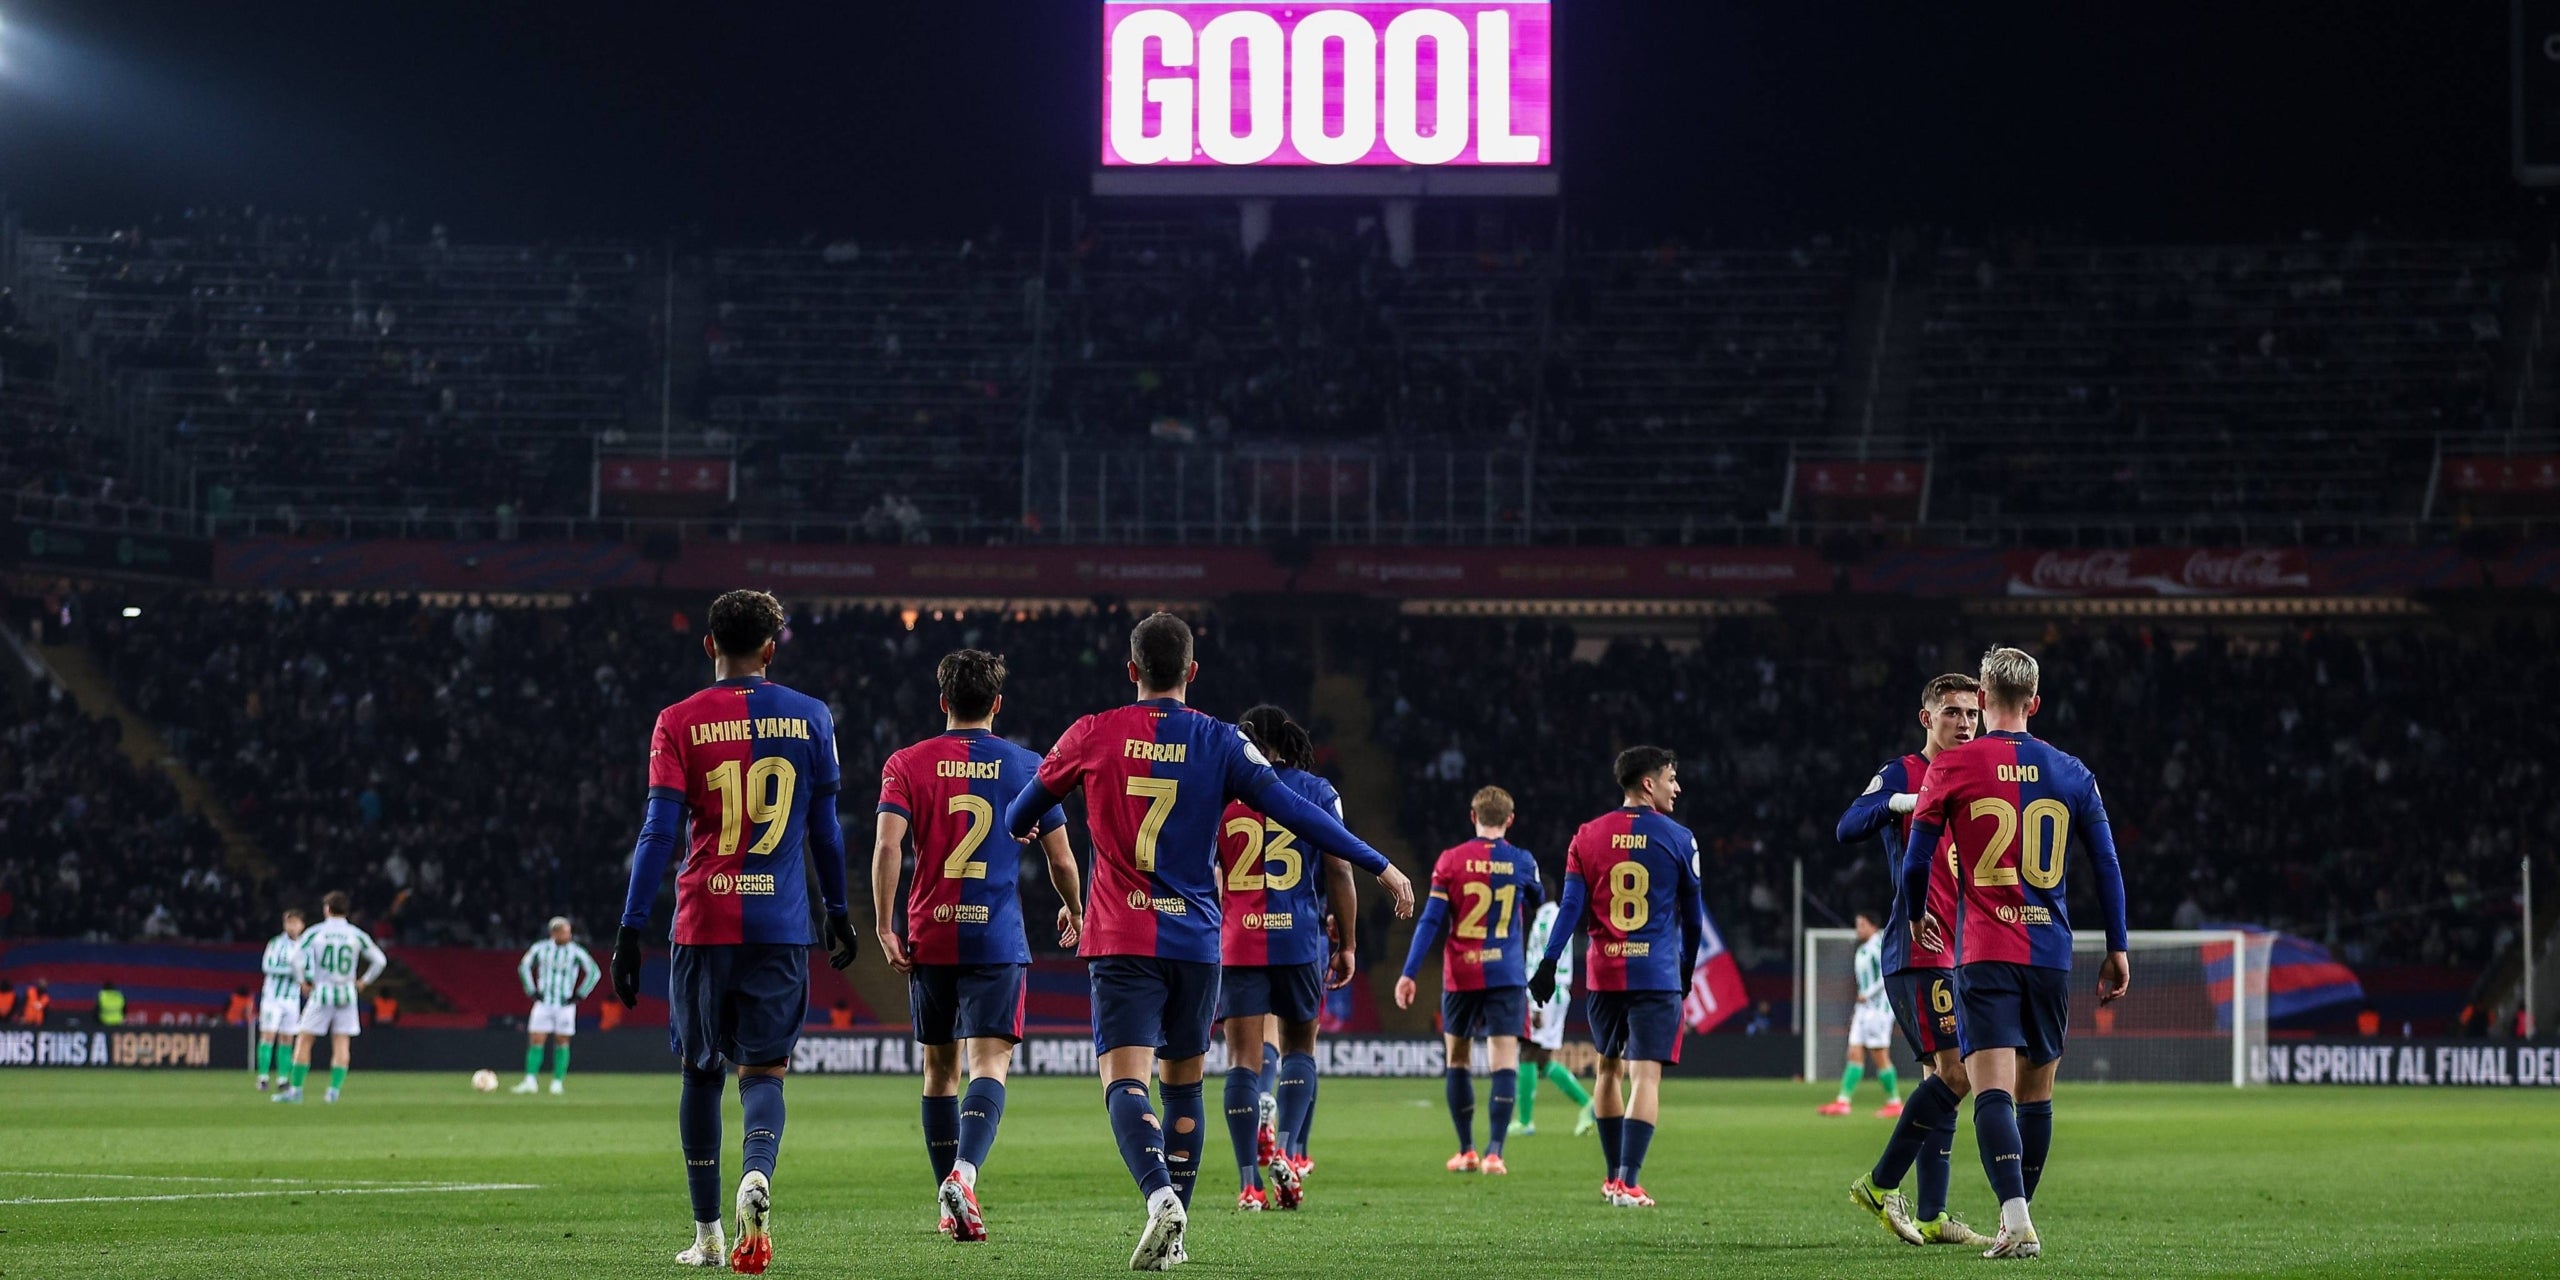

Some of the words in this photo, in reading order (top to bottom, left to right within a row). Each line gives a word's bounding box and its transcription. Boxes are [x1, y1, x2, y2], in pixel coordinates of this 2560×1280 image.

[1110, 8, 1540, 165] GOOOL
[690, 719, 752, 746] LAMINE
[754, 717, 810, 740] YAMAL
[1123, 738, 1187, 763] FERRAN
[936, 759, 1002, 780] CUBARSÍ
[1996, 764, 2039, 783] OLMO
[706, 756, 797, 856] 19
[943, 794, 993, 879] 2
[1126, 775, 1179, 873] 7
[1225, 816, 1302, 892] 23
[1611, 834, 1648, 849] PEDRI
[1970, 797, 2070, 889] 20
[735, 874, 775, 883] UNHCR
[735, 883, 775, 892] ACNUR
[955, 904, 989, 913] UNHCR
[1456, 881, 1517, 940] 21
[1609, 860, 1649, 932] 8
[2020, 905, 2050, 915] UNHCR
[954, 912, 989, 921] ACNUR
[2020, 913, 2052, 922] ACNUR
[321, 943, 353, 976] 46
[1932, 978, 1953, 1014] 6
[37, 1030, 88, 1066] FINS
[90, 1031, 109, 1066] A
[791, 1037, 879, 1073] SPRINT
[880, 1037, 911, 1073] AL
[1029, 1040, 1098, 1074] PARTI
[2250, 1045, 2289, 1084] UN
[2294, 1046, 2394, 1084] SPRINT
[2397, 1046, 2431, 1084] AL
[2436, 1046, 2511, 1085] FINAL
